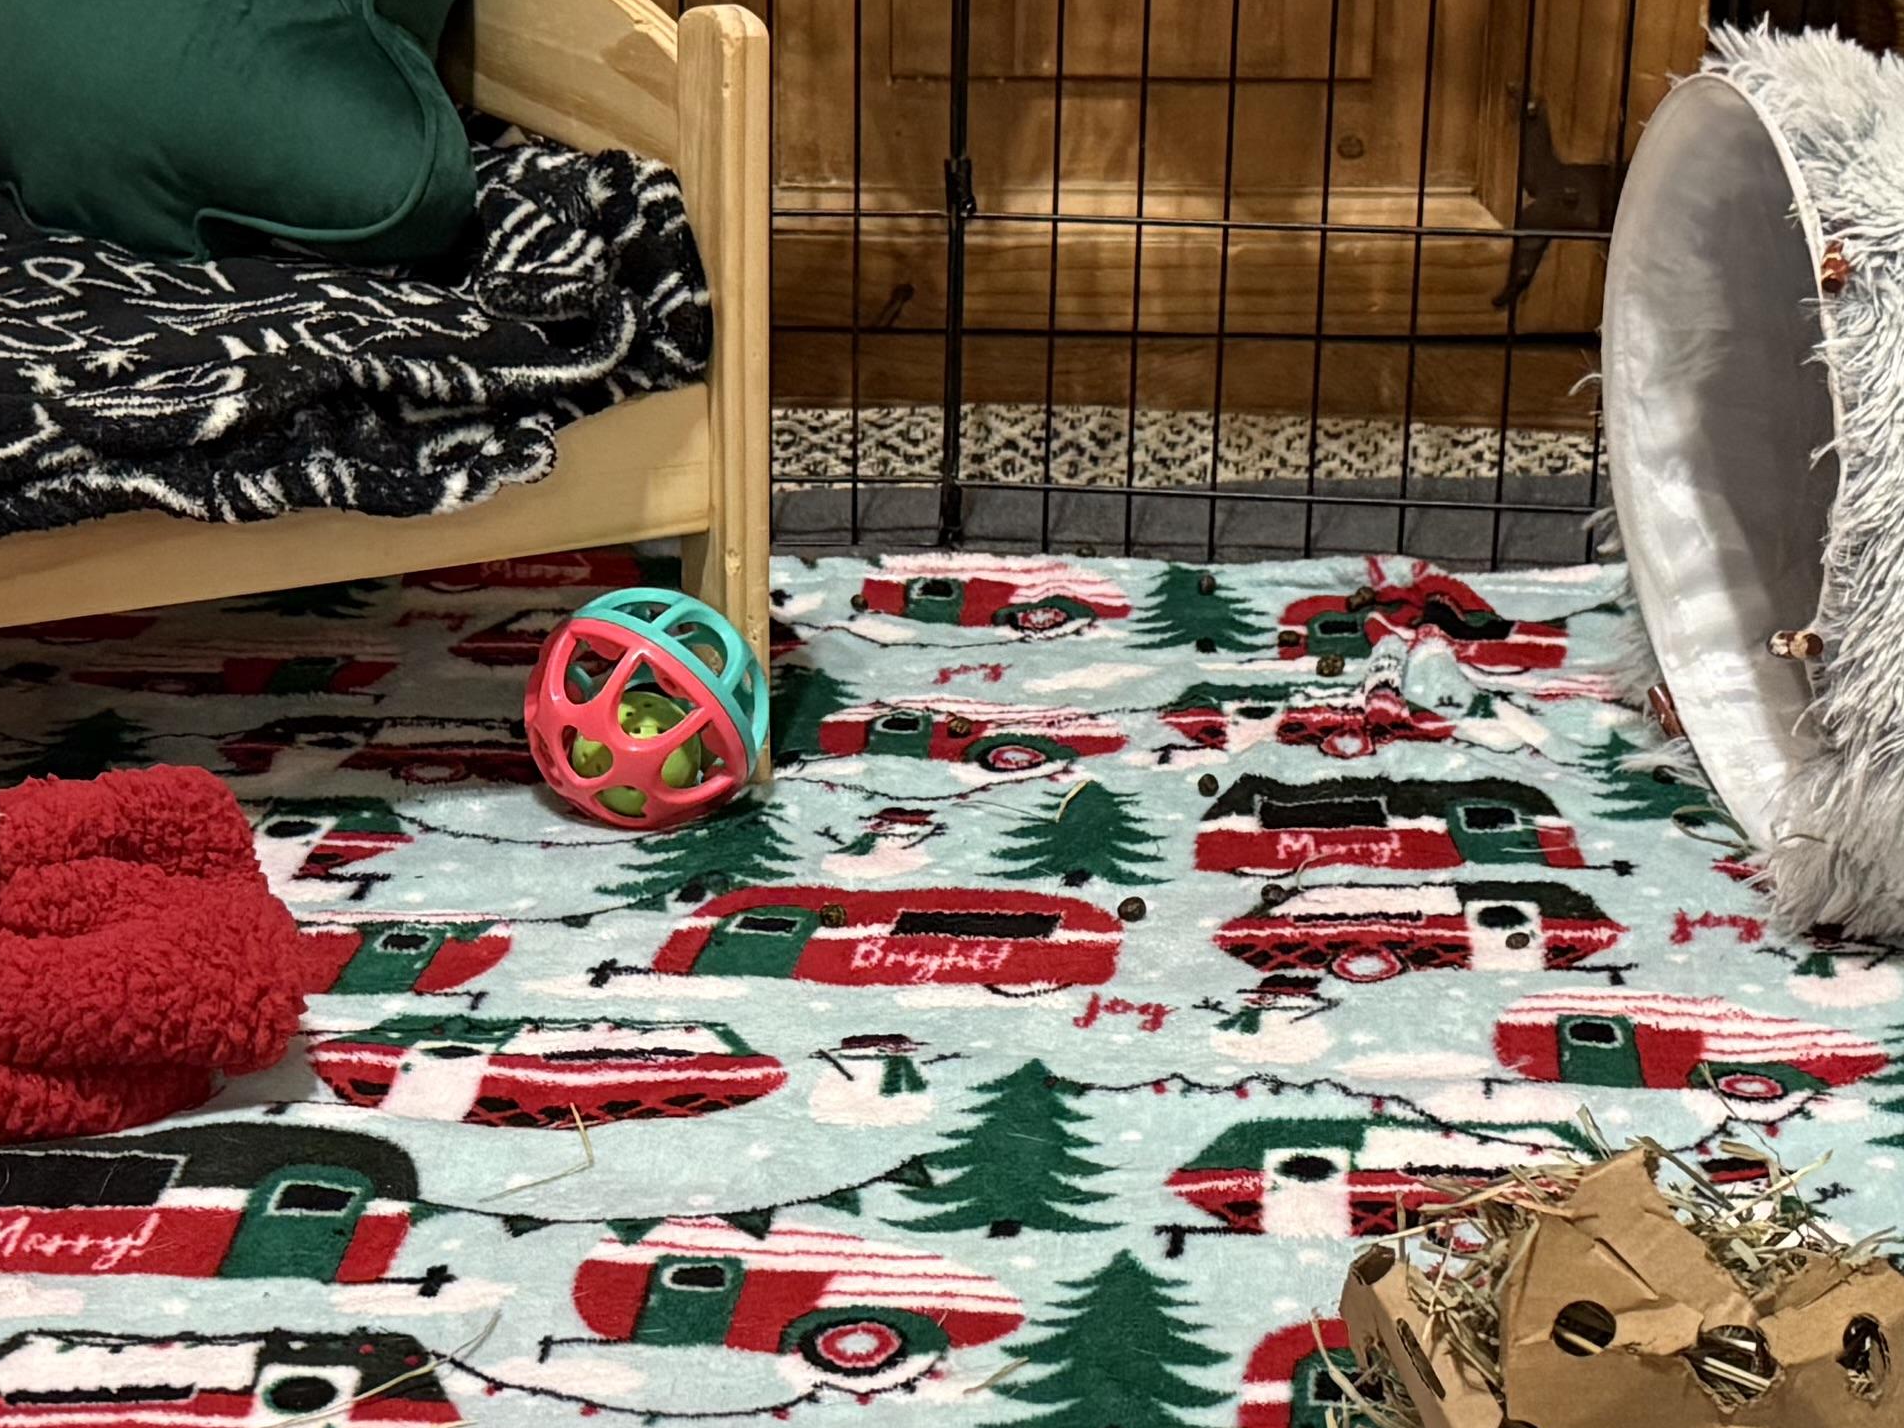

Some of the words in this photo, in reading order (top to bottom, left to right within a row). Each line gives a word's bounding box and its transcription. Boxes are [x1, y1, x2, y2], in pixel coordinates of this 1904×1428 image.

[932, 662, 1012, 684] joy
[1276, 832, 1402, 864] Merry!
[1670, 907, 1765, 943] joy
[851, 938, 1013, 983] Bright!
[1072, 991, 1177, 1030] joy
